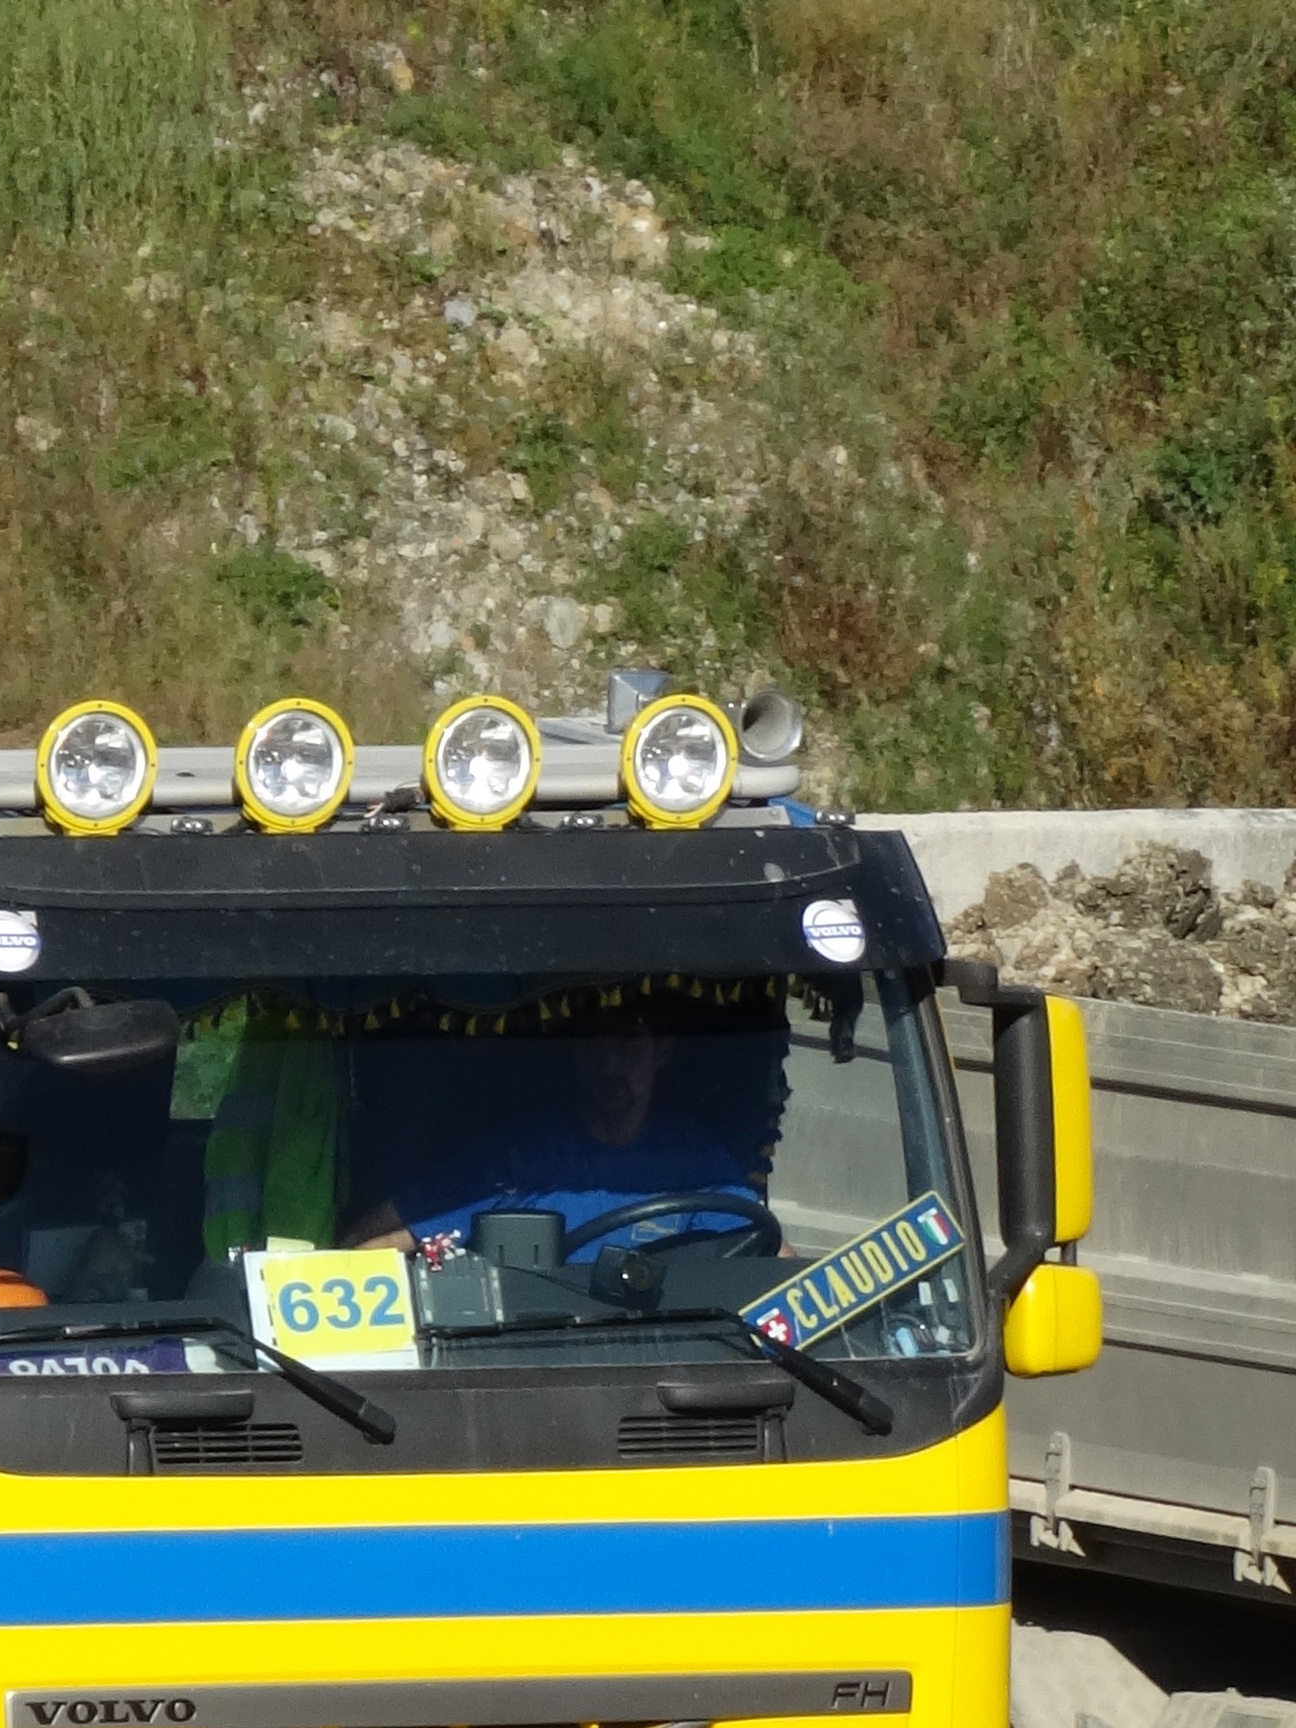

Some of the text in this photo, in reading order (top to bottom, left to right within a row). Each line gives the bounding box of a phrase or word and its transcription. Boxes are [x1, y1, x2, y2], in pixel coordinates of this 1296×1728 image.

[808, 924, 863, 938] VOLVO
[786, 1220, 927, 1329] CLAUDIO
[278, 1275, 406, 1333] 632
[831, 1679, 891, 1709] FH
[25, 1698, 197, 1726] VOLVO
